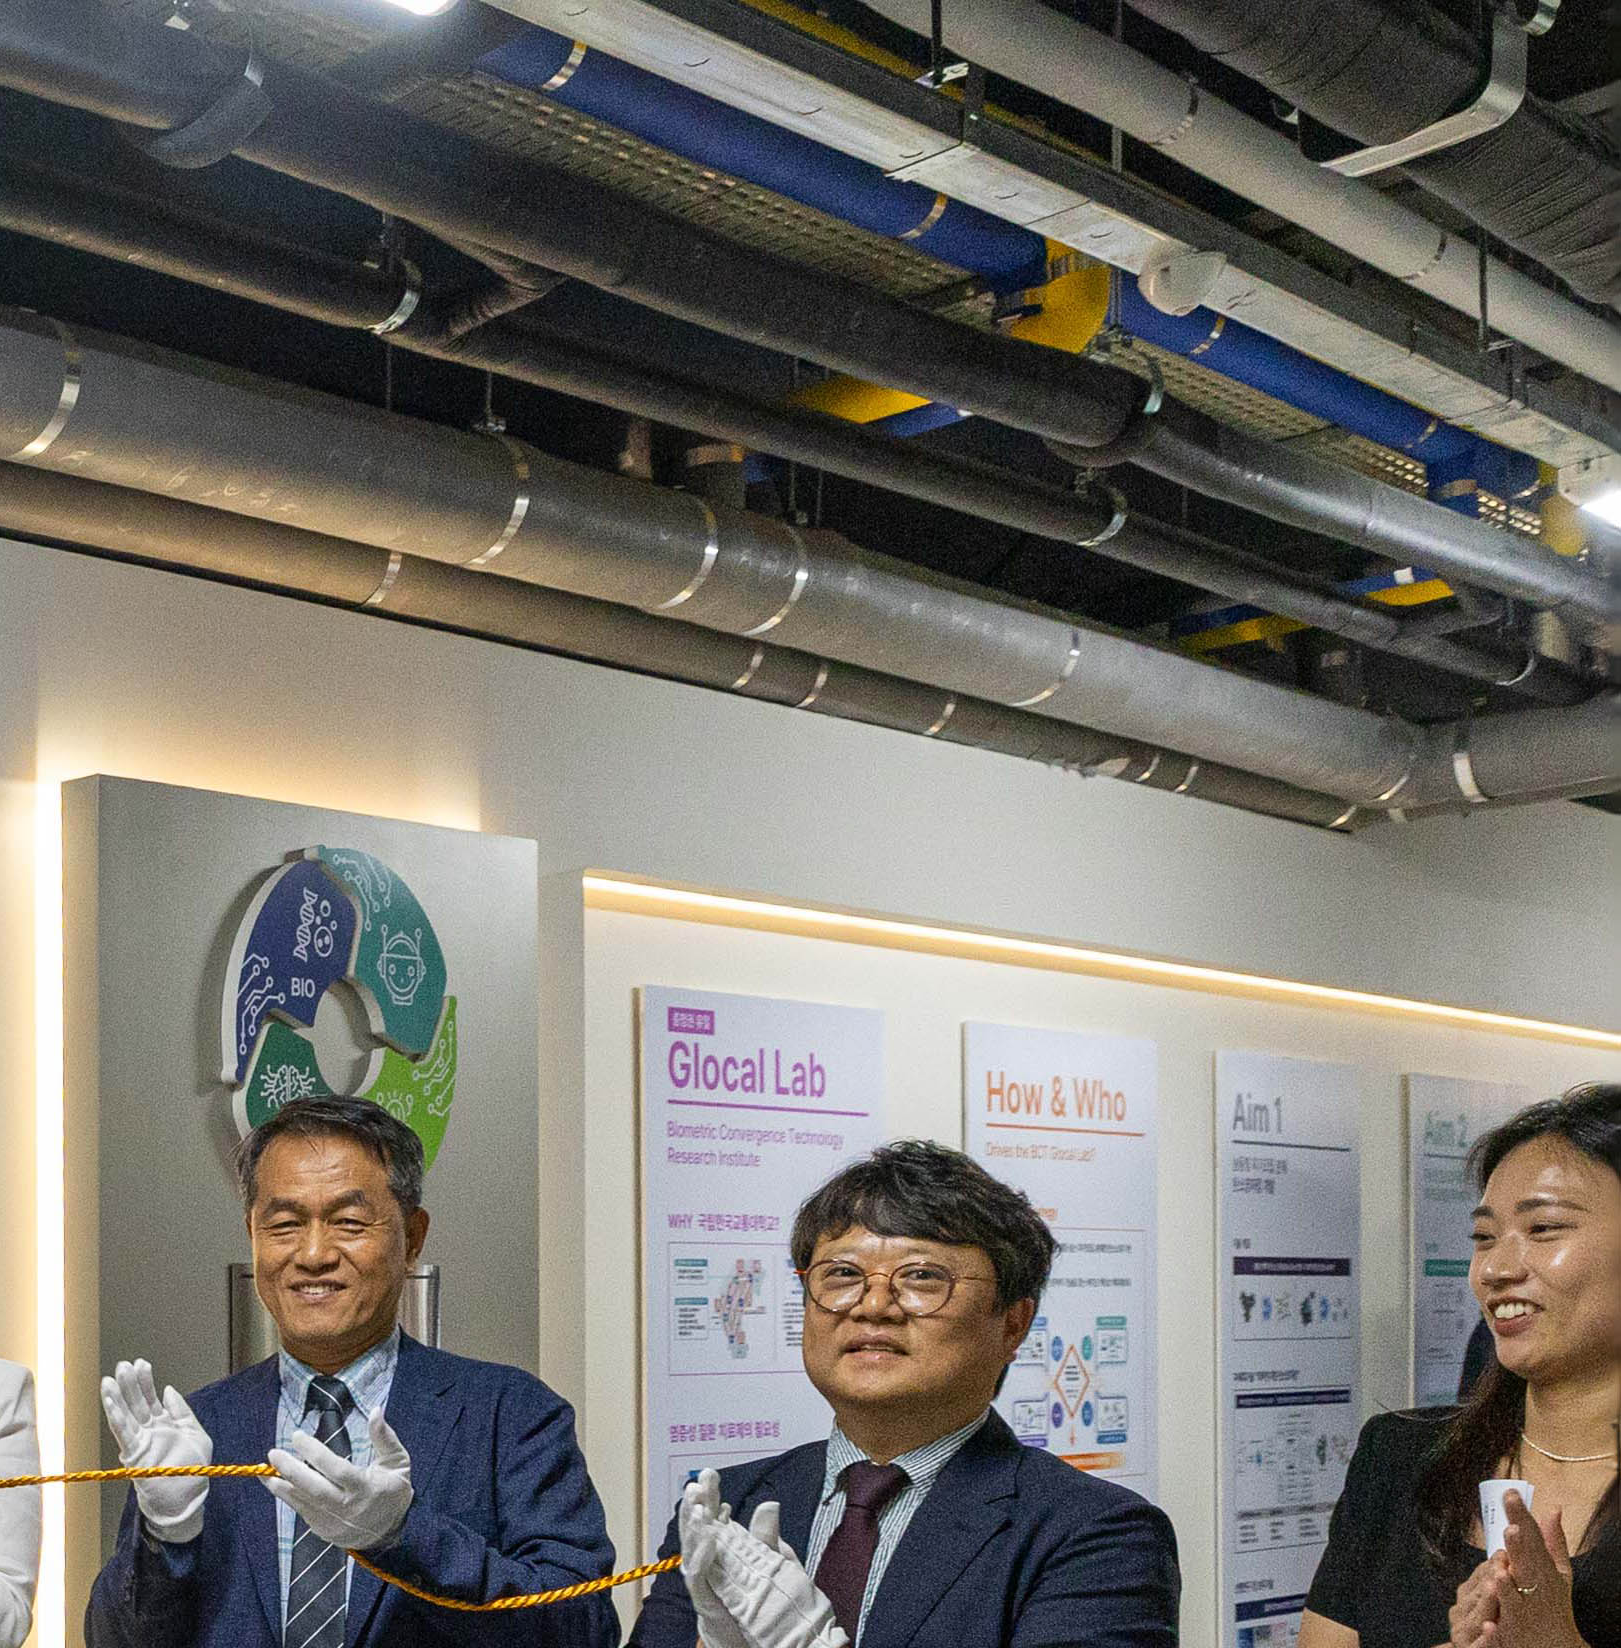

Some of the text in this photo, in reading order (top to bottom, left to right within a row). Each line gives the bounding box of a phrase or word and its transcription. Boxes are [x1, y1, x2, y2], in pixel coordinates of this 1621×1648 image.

[290, 977, 315, 998] BIO
[668, 1040, 827, 1099] Glocal Lab
[986, 1070, 1127, 1122] How & Who
[1232, 1093, 1283, 1134] Aim 1
[666, 1120, 717, 1140] Biometric
[668, 1213, 693, 1230] WHY
